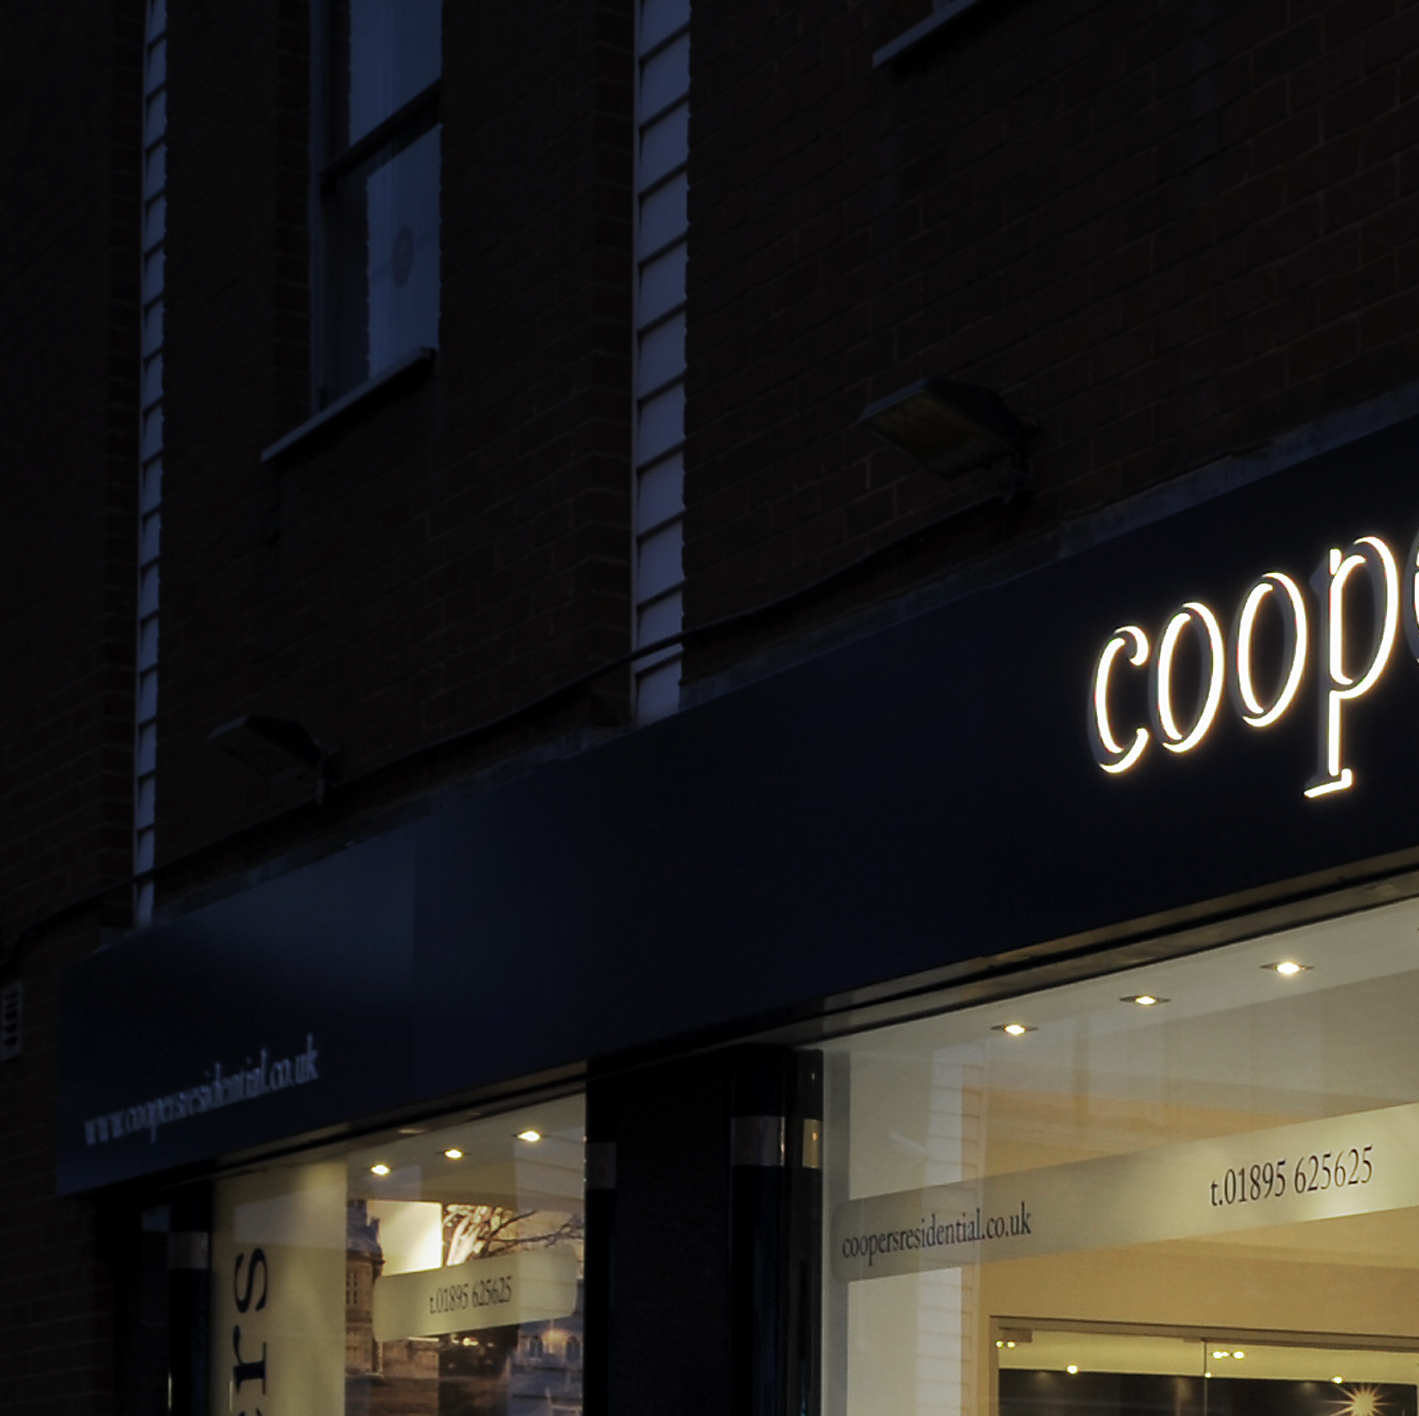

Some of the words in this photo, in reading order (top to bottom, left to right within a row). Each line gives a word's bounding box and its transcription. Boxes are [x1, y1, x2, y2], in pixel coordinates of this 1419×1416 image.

[842, 1201, 1032, 1266] coopersresidential.co.uk
[1209, 1158, 1287, 1208] t.01895
[1293, 1144, 1374, 1195] 625625
[429, 1283, 469, 1314] t.01895
[472, 1275, 512, 1309] 625625
